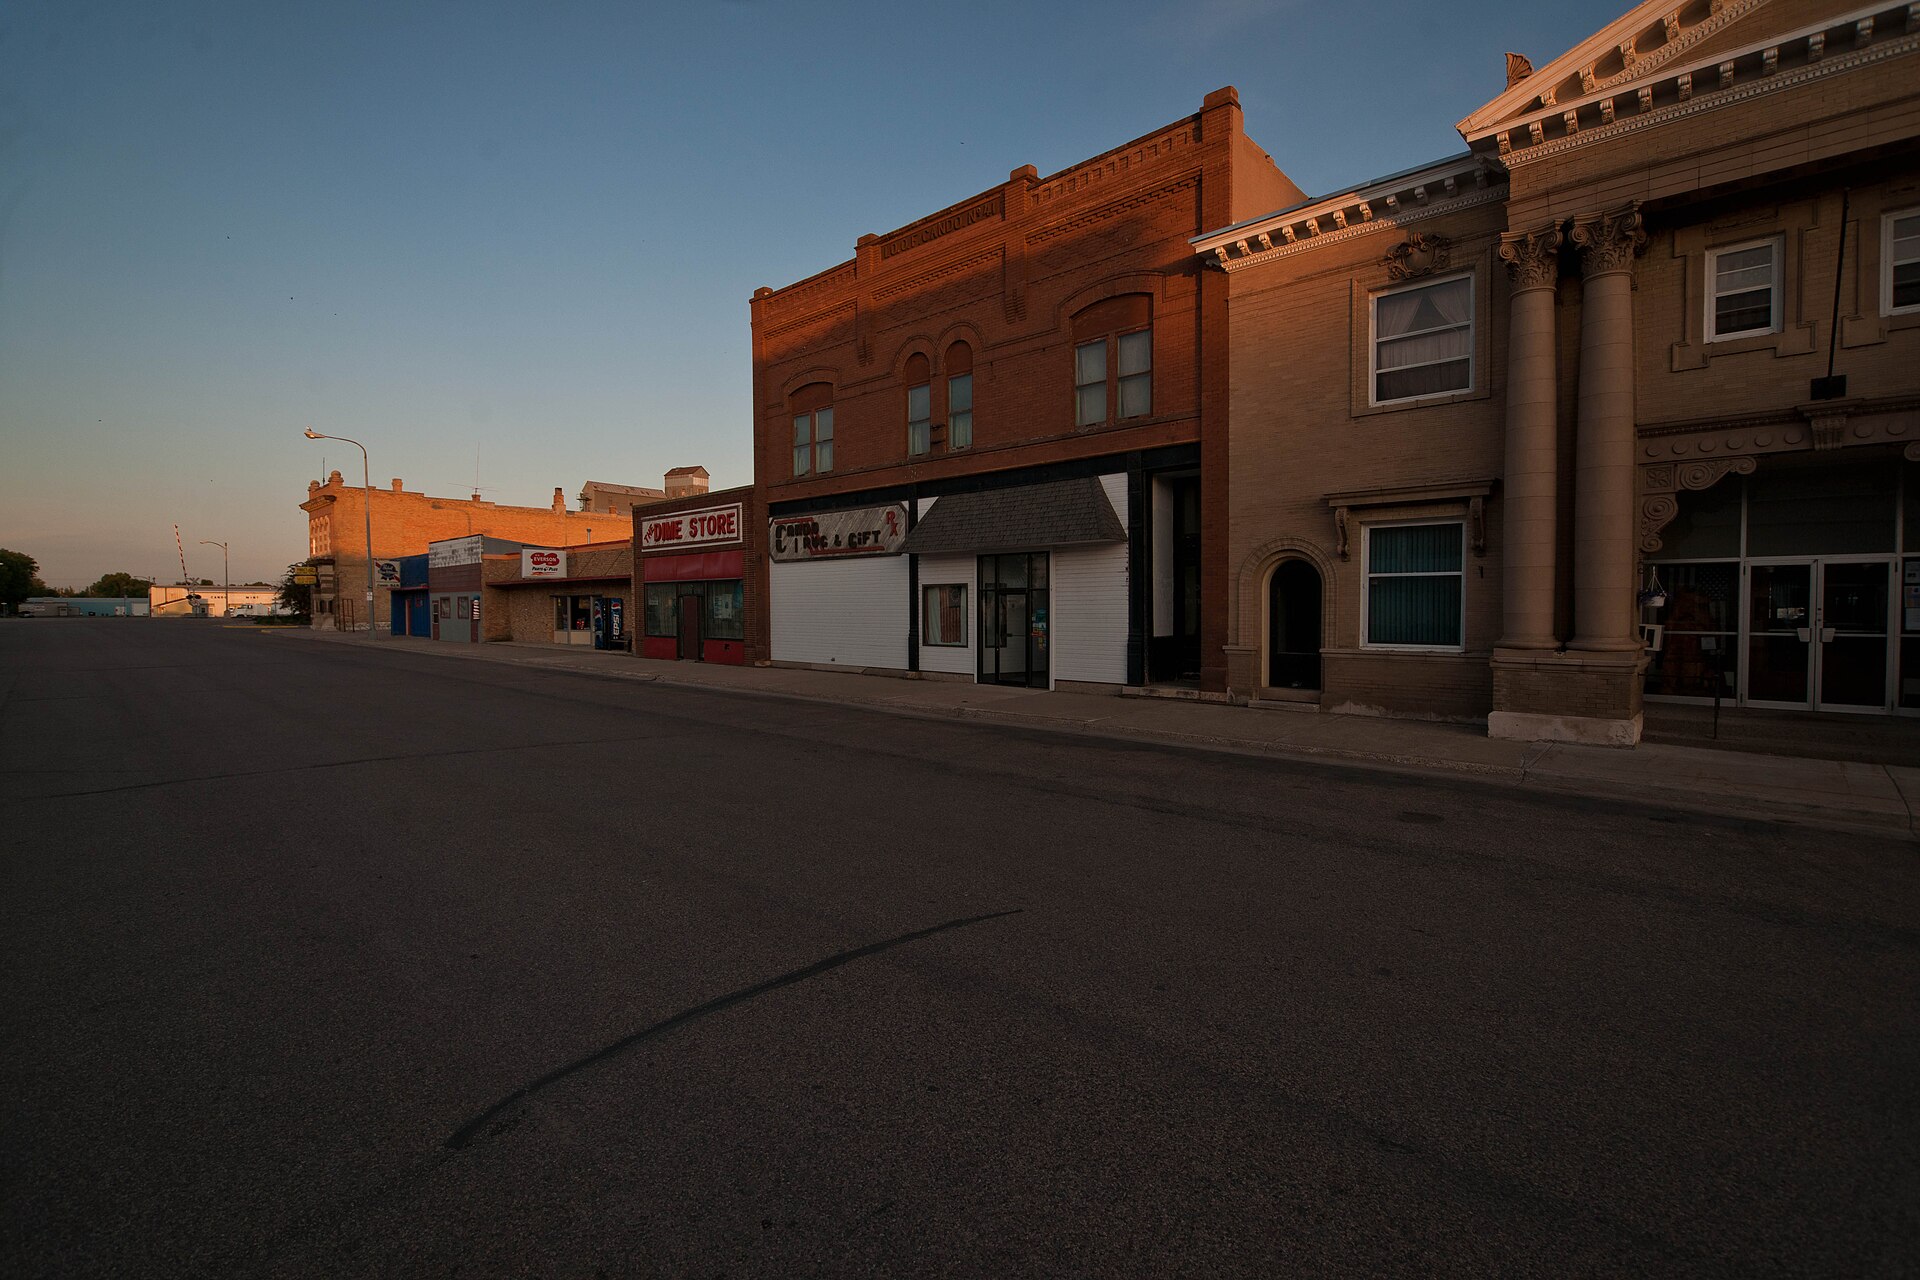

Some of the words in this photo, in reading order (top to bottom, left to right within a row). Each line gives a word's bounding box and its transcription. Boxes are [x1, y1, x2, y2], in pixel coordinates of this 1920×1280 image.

[644, 523, 655, 543] THE
[653, 519, 683, 542] DIME
[689, 512, 736, 537] STORE
[833, 534, 842, 547] &
